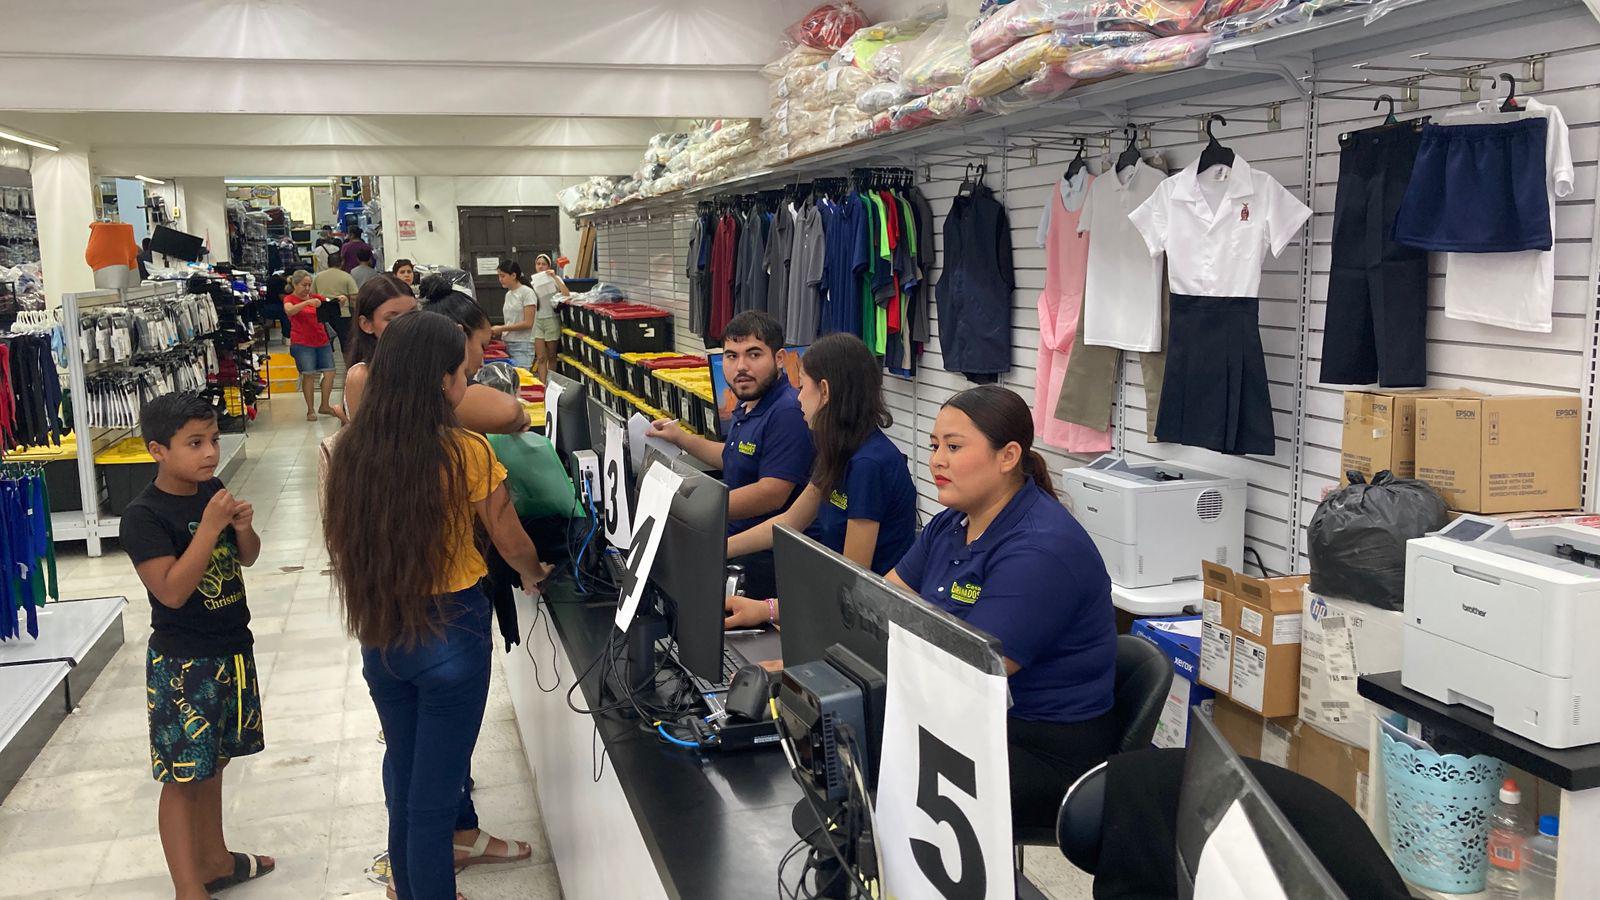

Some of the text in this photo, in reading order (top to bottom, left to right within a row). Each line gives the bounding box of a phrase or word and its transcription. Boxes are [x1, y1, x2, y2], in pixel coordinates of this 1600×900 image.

[1372, 403, 1387, 411] EPSON
[1456, 409, 1475, 417] EPSON
[1556, 409, 1578, 417] EPSON
[606, 459, 617, 535] 3
[617, 515, 656, 611] 4
[1462, 603, 1486, 617] brother
[1173, 656, 1193, 673] xerox
[173, 698, 210, 740] Dior
[909, 724, 987, 900] 5
